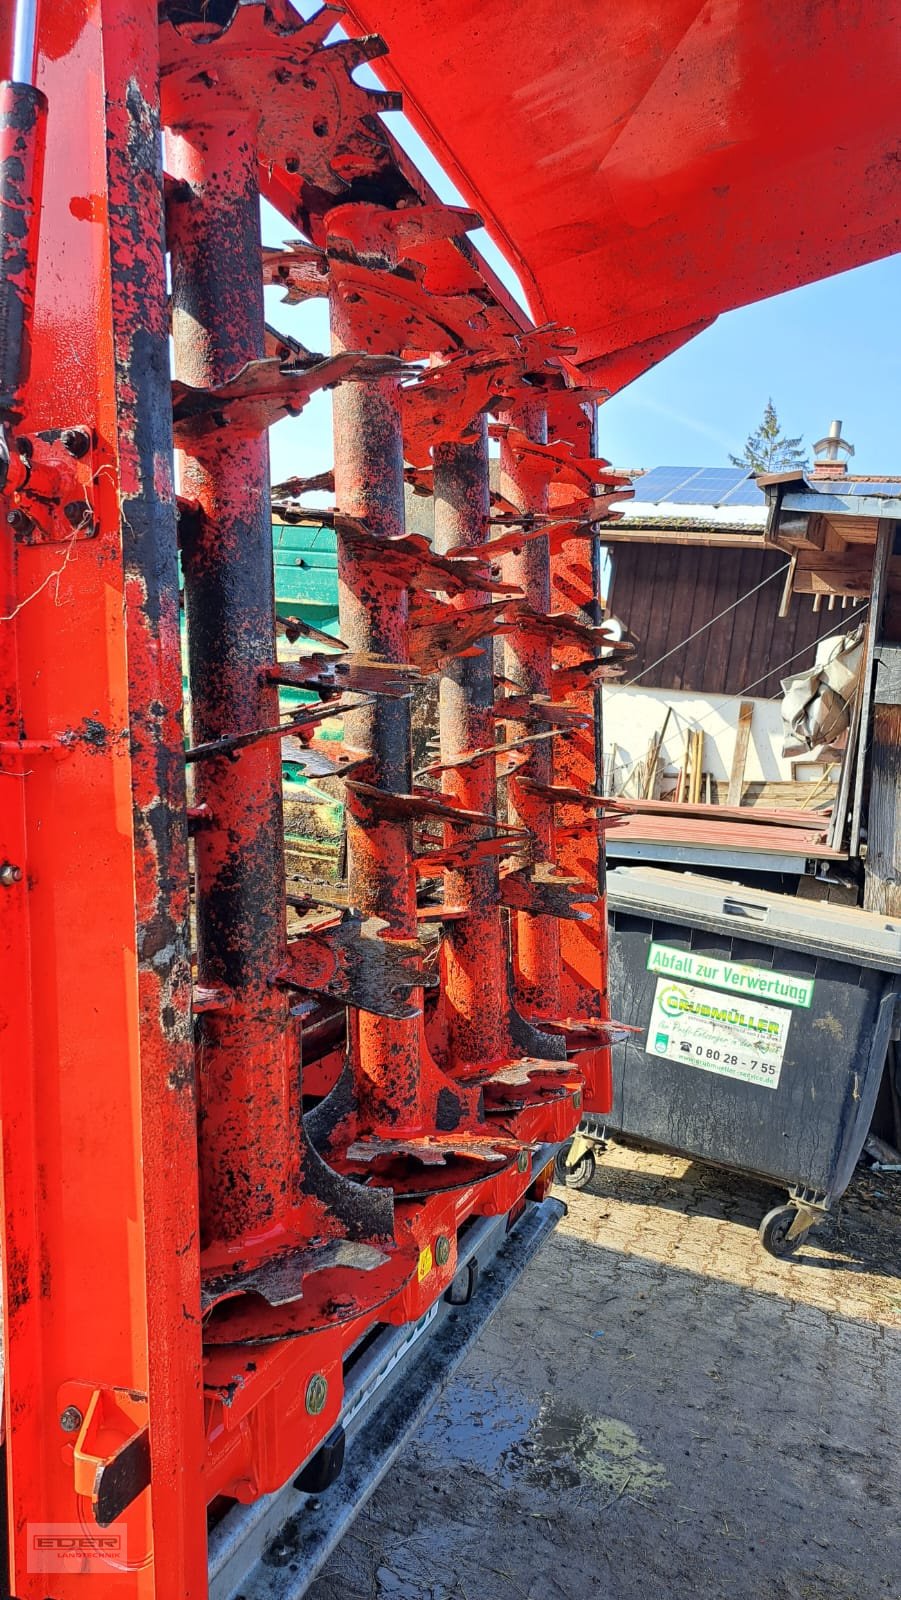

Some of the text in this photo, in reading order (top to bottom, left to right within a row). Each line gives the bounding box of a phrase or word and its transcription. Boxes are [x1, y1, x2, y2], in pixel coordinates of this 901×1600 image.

[652, 951, 808, 1004] Abfall zur Verwertung
[666, 995, 780, 1036] GRUBMÜLLER
[695, 1045, 703, 1056] 0
[705, 1048, 721, 1061] 80
[723, 1053, 738, 1066] 28
[750, 1060, 758, 1071] 7
[760, 1063, 776, 1076] 55
